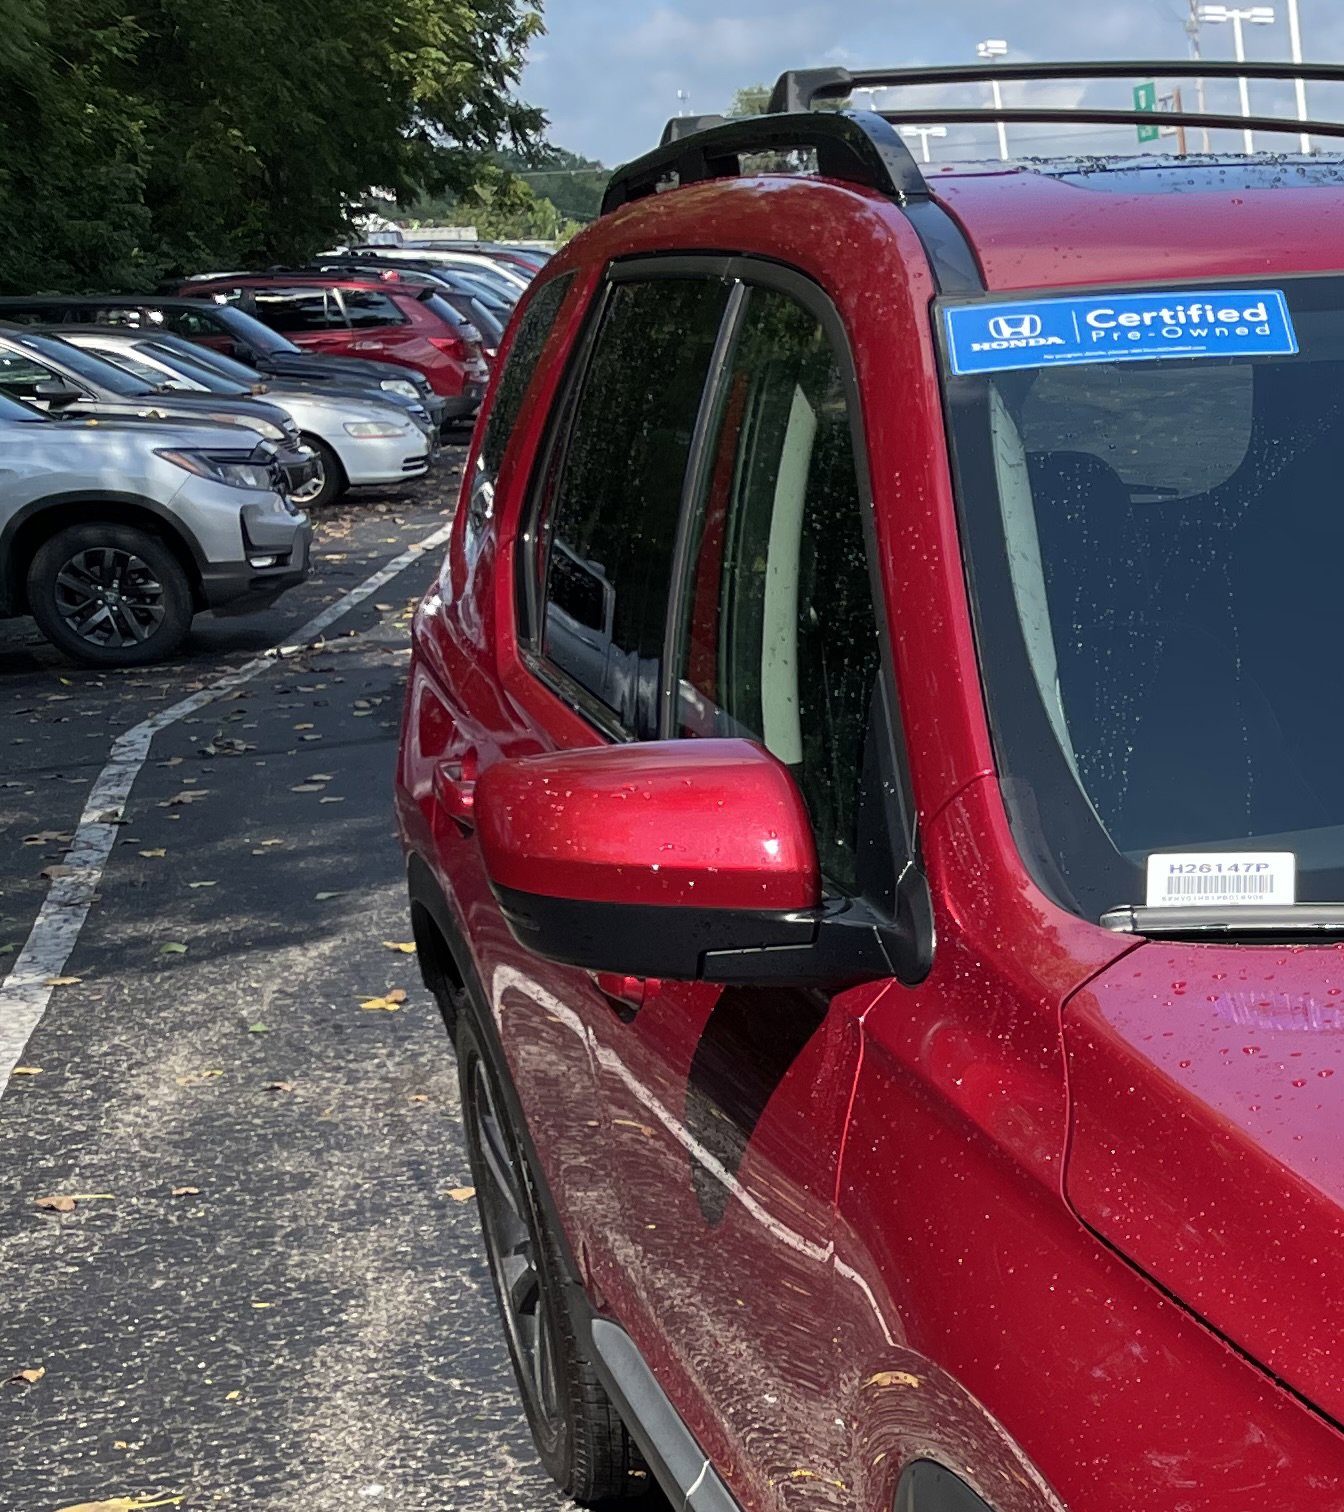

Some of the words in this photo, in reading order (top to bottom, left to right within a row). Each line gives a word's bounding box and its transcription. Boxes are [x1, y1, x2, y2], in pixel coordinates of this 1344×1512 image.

[1086, 302, 1269, 329] Certified
[1091, 323, 1271, 343] Pre-Owned
[970, 336, 1067, 352] HONDA
[1169, 863, 1270, 874] H26147P
